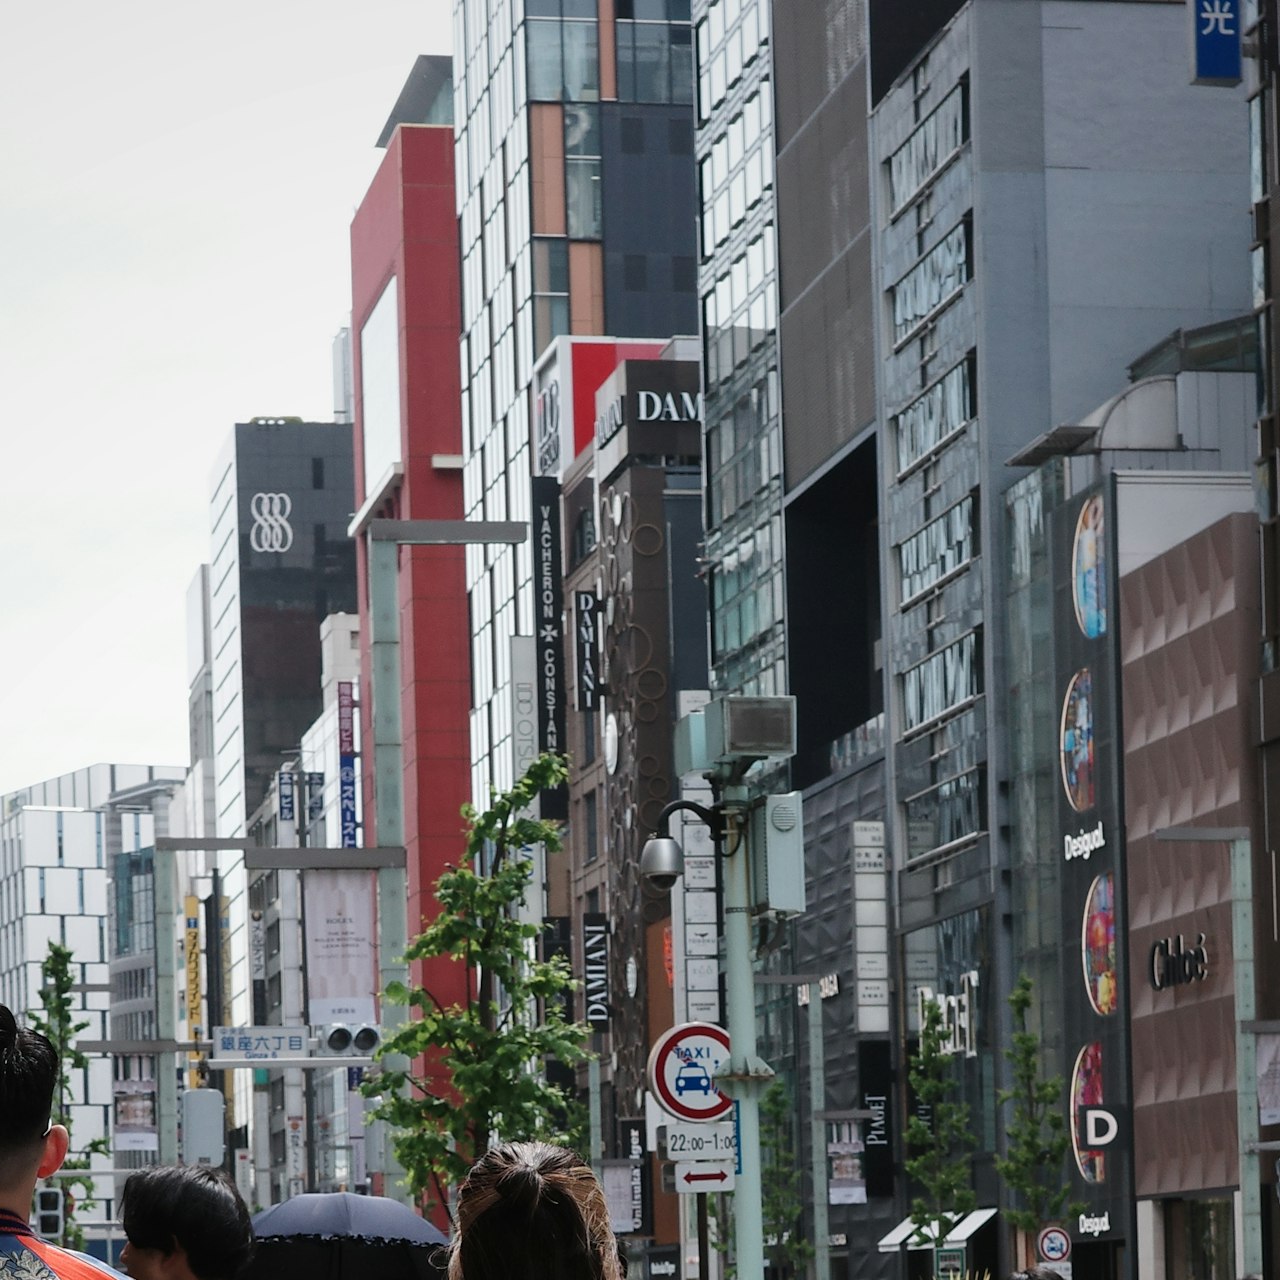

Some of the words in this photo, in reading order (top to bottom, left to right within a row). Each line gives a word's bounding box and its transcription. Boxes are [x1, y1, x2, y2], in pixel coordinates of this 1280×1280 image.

[540, 505, 554, 619] VACHERON
[579, 593, 595, 708] DAMIANI
[518, 719, 535, 775] OTSU
[544, 648, 558, 790] CONSTAN
[585, 924, 609, 1021] DAMIANI
[1150, 932, 1208, 991] Chloé
[221, 1035, 303, 1050] 銀座六丁目
[674, 1047, 710, 1059] TAXI
[1086, 1109, 1118, 1146] D
